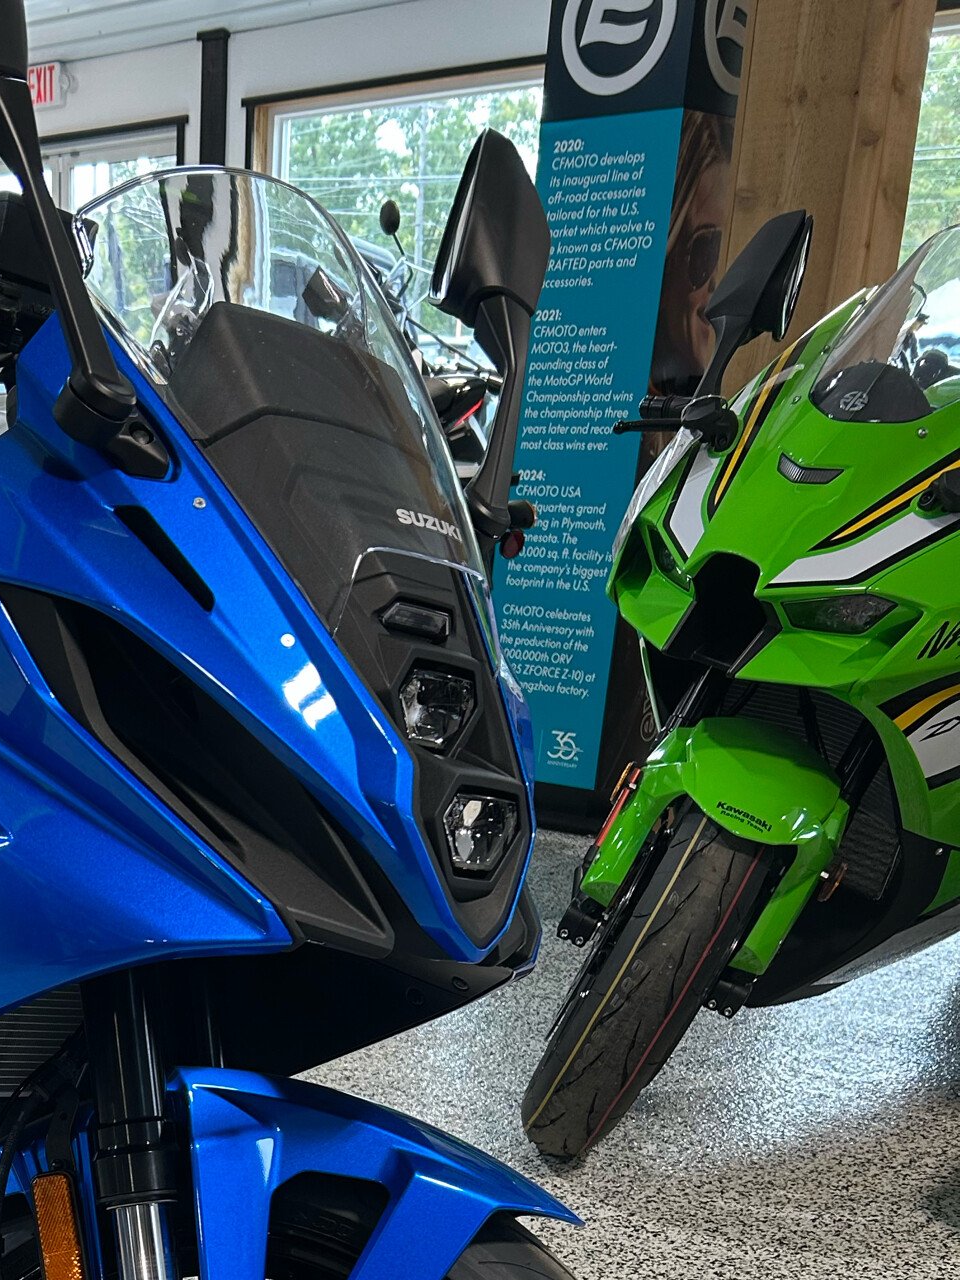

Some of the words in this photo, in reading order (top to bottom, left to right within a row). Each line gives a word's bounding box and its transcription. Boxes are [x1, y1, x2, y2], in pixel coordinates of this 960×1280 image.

[27, 64, 55, 105] EXIT
[554, 139, 584, 153] 2020:
[552, 154, 598, 170] CFMOTO
[600, 151, 645, 166] develops
[550, 176, 560, 188] its
[562, 171, 610, 188] inaugural
[612, 170, 629, 182] line
[632, 167, 643, 179] of
[548, 190, 588, 204] off-road
[591, 187, 646, 200] accessories
[547, 207, 586, 221] tailored
[586, 206, 600, 218] for
[602, 204, 617, 217] the
[621, 202, 639, 216] U.S.
[580, 220, 607, 235] which
[610, 220, 642, 232] evolve
[645, 220, 655, 231] to
[557, 239, 590, 254] known
[591, 241, 601, 252] as
[605, 236, 652, 250] CFMOTO
[546, 258, 588, 271] RAFTED
[588, 257, 615, 272] parts
[616, 254, 637, 266] and
[535, 310, 562, 321] 2021:
[534, 325, 577, 338] CFMOTO
[578, 326, 606, 336] enters
[531, 342, 571, 354] MOTO3,
[572, 343, 587, 353] the
[589, 341, 617, 352] heart-
[529, 360, 572, 373] pounding
[575, 357, 595, 369] class
[598, 356, 609, 369] of
[528, 376, 541, 386] the
[544, 374, 583, 386] MotoGP
[584, 374, 613, 385] World
[527, 391, 590, 405] Championship
[592, 390, 610, 401] and
[613, 391, 633, 401] wins
[525, 408, 538, 418] the
[540, 407, 602, 421] championship
[605, 407, 628, 418] three
[522, 425, 546, 437] years
[548, 423, 568, 434] later
[571, 423, 589, 434] and
[521, 439, 541, 450] most
[543, 438, 564, 450] class
[566, 439, 585, 450] wins
[587, 441, 608, 451] ever.
[518, 470, 546, 481] 2024:
[516, 485, 559, 497] CFMOTO
[561, 486, 581, 497] USA
[577, 503, 606, 516] grand
[396, 508, 462, 543] SUZUKI
[551, 520, 559, 528] in
[562, 519, 606, 532] Plymouth,
[562, 533, 577, 545] The
[547, 550, 560, 561] sq.
[572, 549, 604, 564] facility
[605, 552, 612, 562] is
[508, 560, 521, 571] the
[523, 565, 570, 577] company's
[572, 565, 608, 580] biggest
[506, 575, 544, 589] footprint
[546, 578, 552, 589] in
[556, 579, 570, 590] the
[573, 580, 590, 592] U.S.
[502, 604, 544, 617] CFMOTO
[545, 608, 591, 622] celebrates
[501, 619, 520, 631] 35th
[521, 620, 575, 638] Anniversary
[576, 626, 594, 637] with
[500, 634, 513, 644] the
[514, 636, 561, 649] production
[563, 640, 573, 651] of
[574, 641, 588, 652] the
[551, 653, 572, 664] ORV
[523, 664, 560, 679] ZFORCE
[562, 668, 584, 684] Z-10)
[585, 673, 595, 682] at
[556, 681, 590, 699] factory.
[716, 800, 773, 832] Kawasaki
